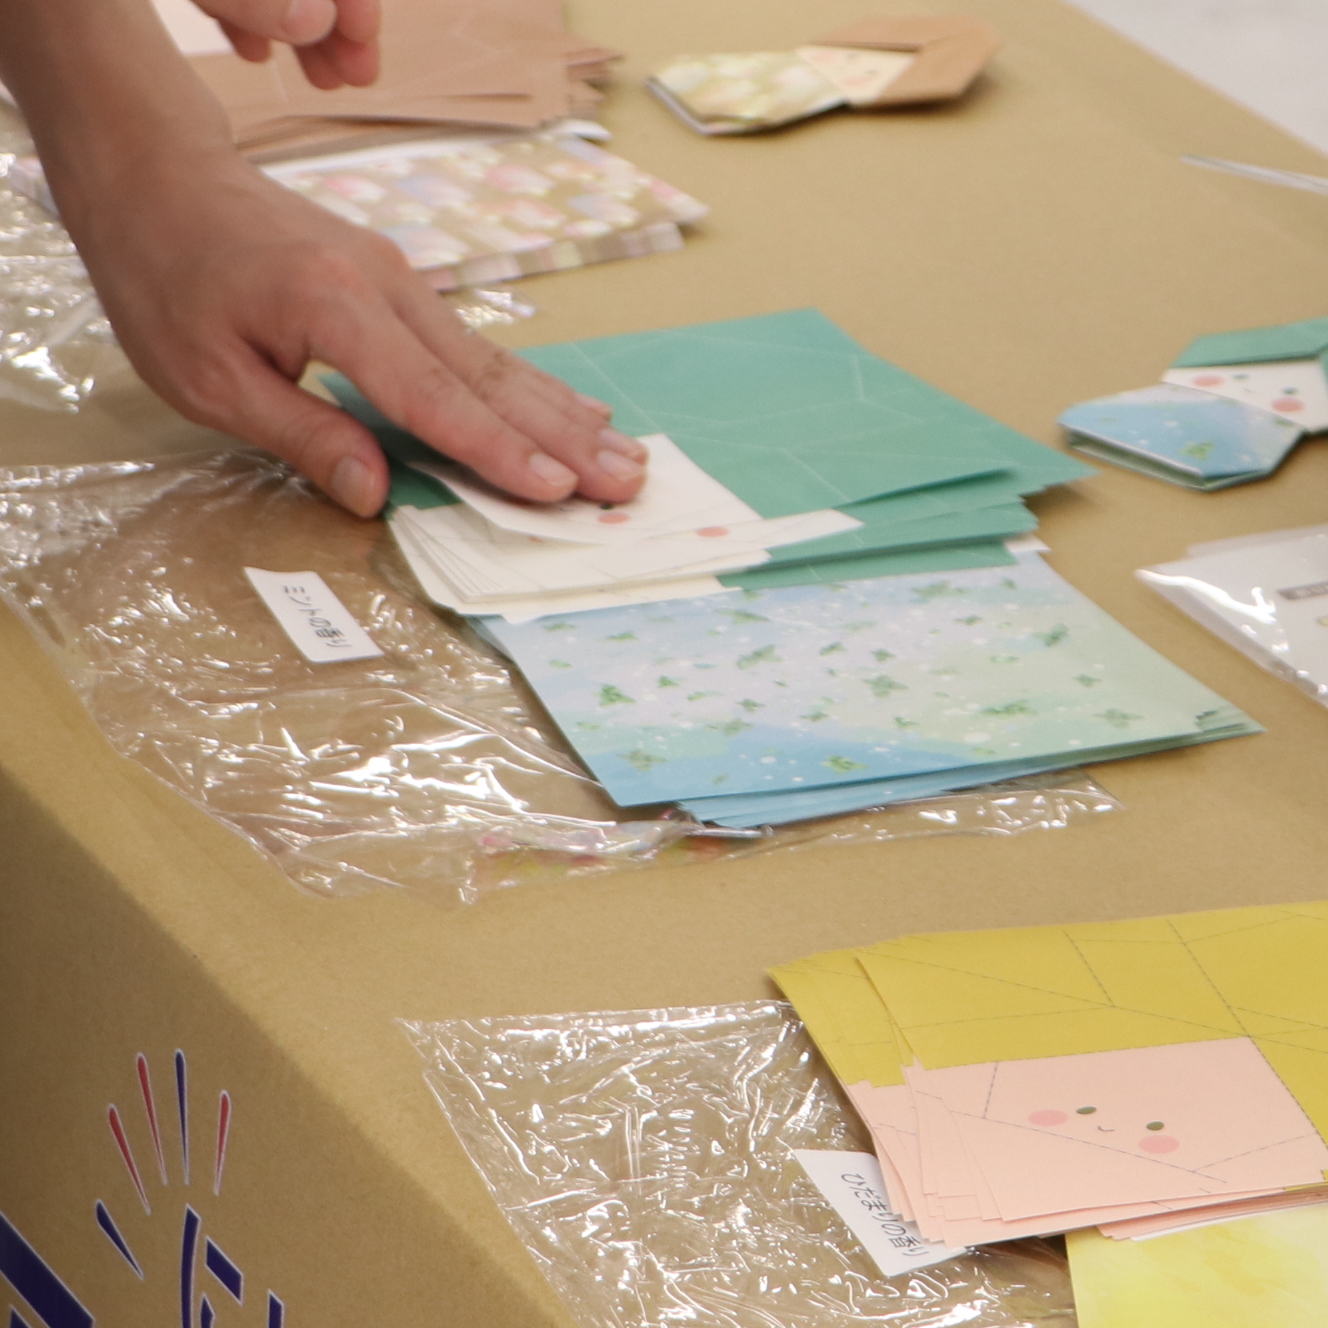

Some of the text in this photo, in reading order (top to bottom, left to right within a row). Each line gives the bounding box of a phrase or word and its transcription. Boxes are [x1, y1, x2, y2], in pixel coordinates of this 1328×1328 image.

[282, 585, 352, 648] ミントの香り
[841, 1173, 930, 1257] ひだまりの香り
